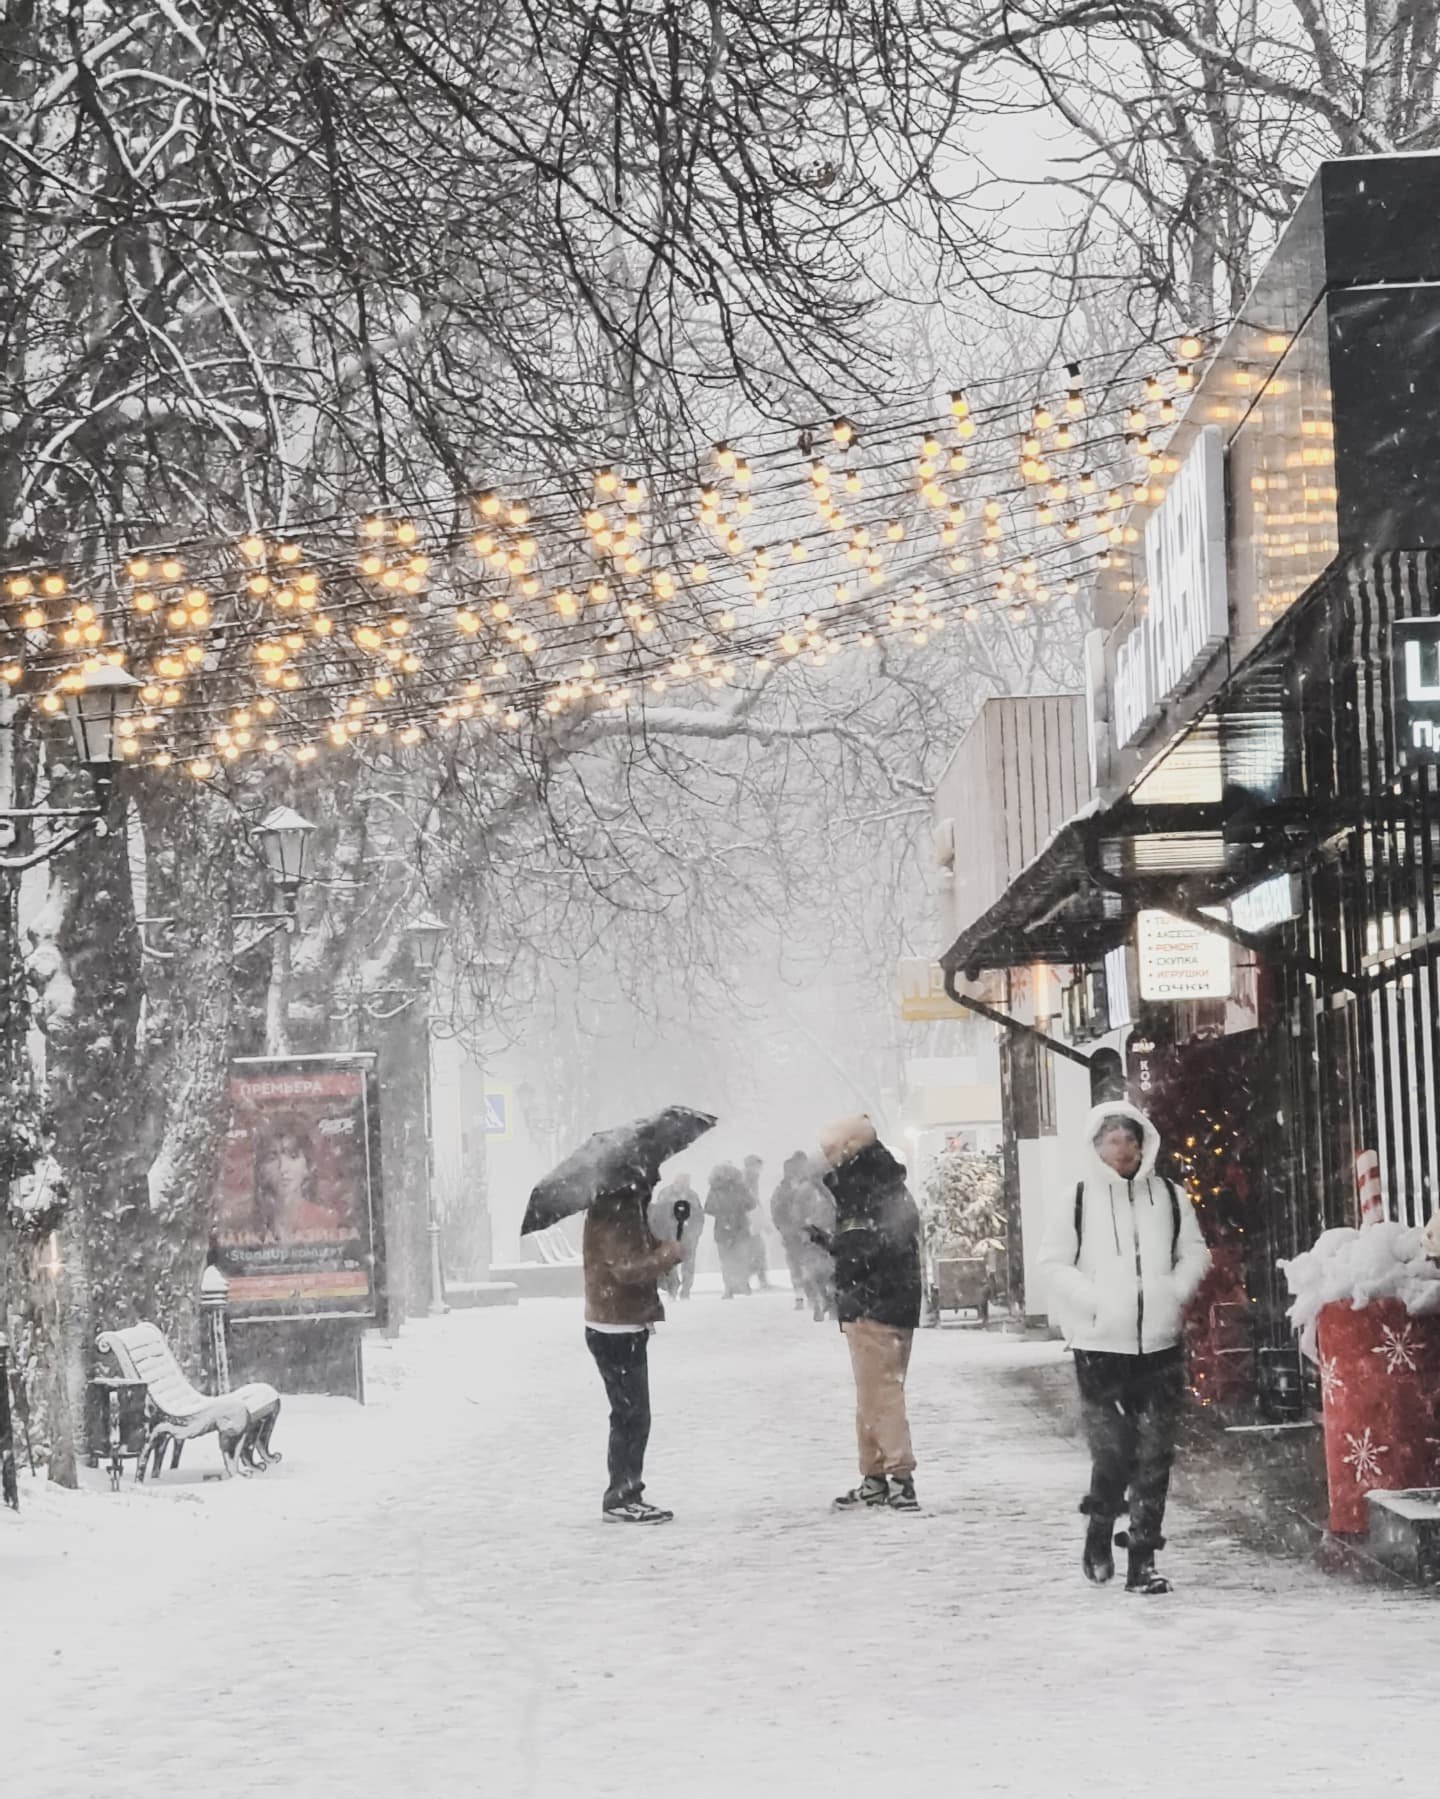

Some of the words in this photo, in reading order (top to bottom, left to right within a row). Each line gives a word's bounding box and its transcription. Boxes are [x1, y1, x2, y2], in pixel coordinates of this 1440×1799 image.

[1155, 942, 1200, 952] РЕМОНТ
[1157, 956, 1200, 966] СКУПКА
[1157, 968, 1209, 979] ИГРУШКИ
[1158, 983, 1209, 993] ОЧКИ
[240, 1080, 323, 1096] ПРЕМЬЕРА
